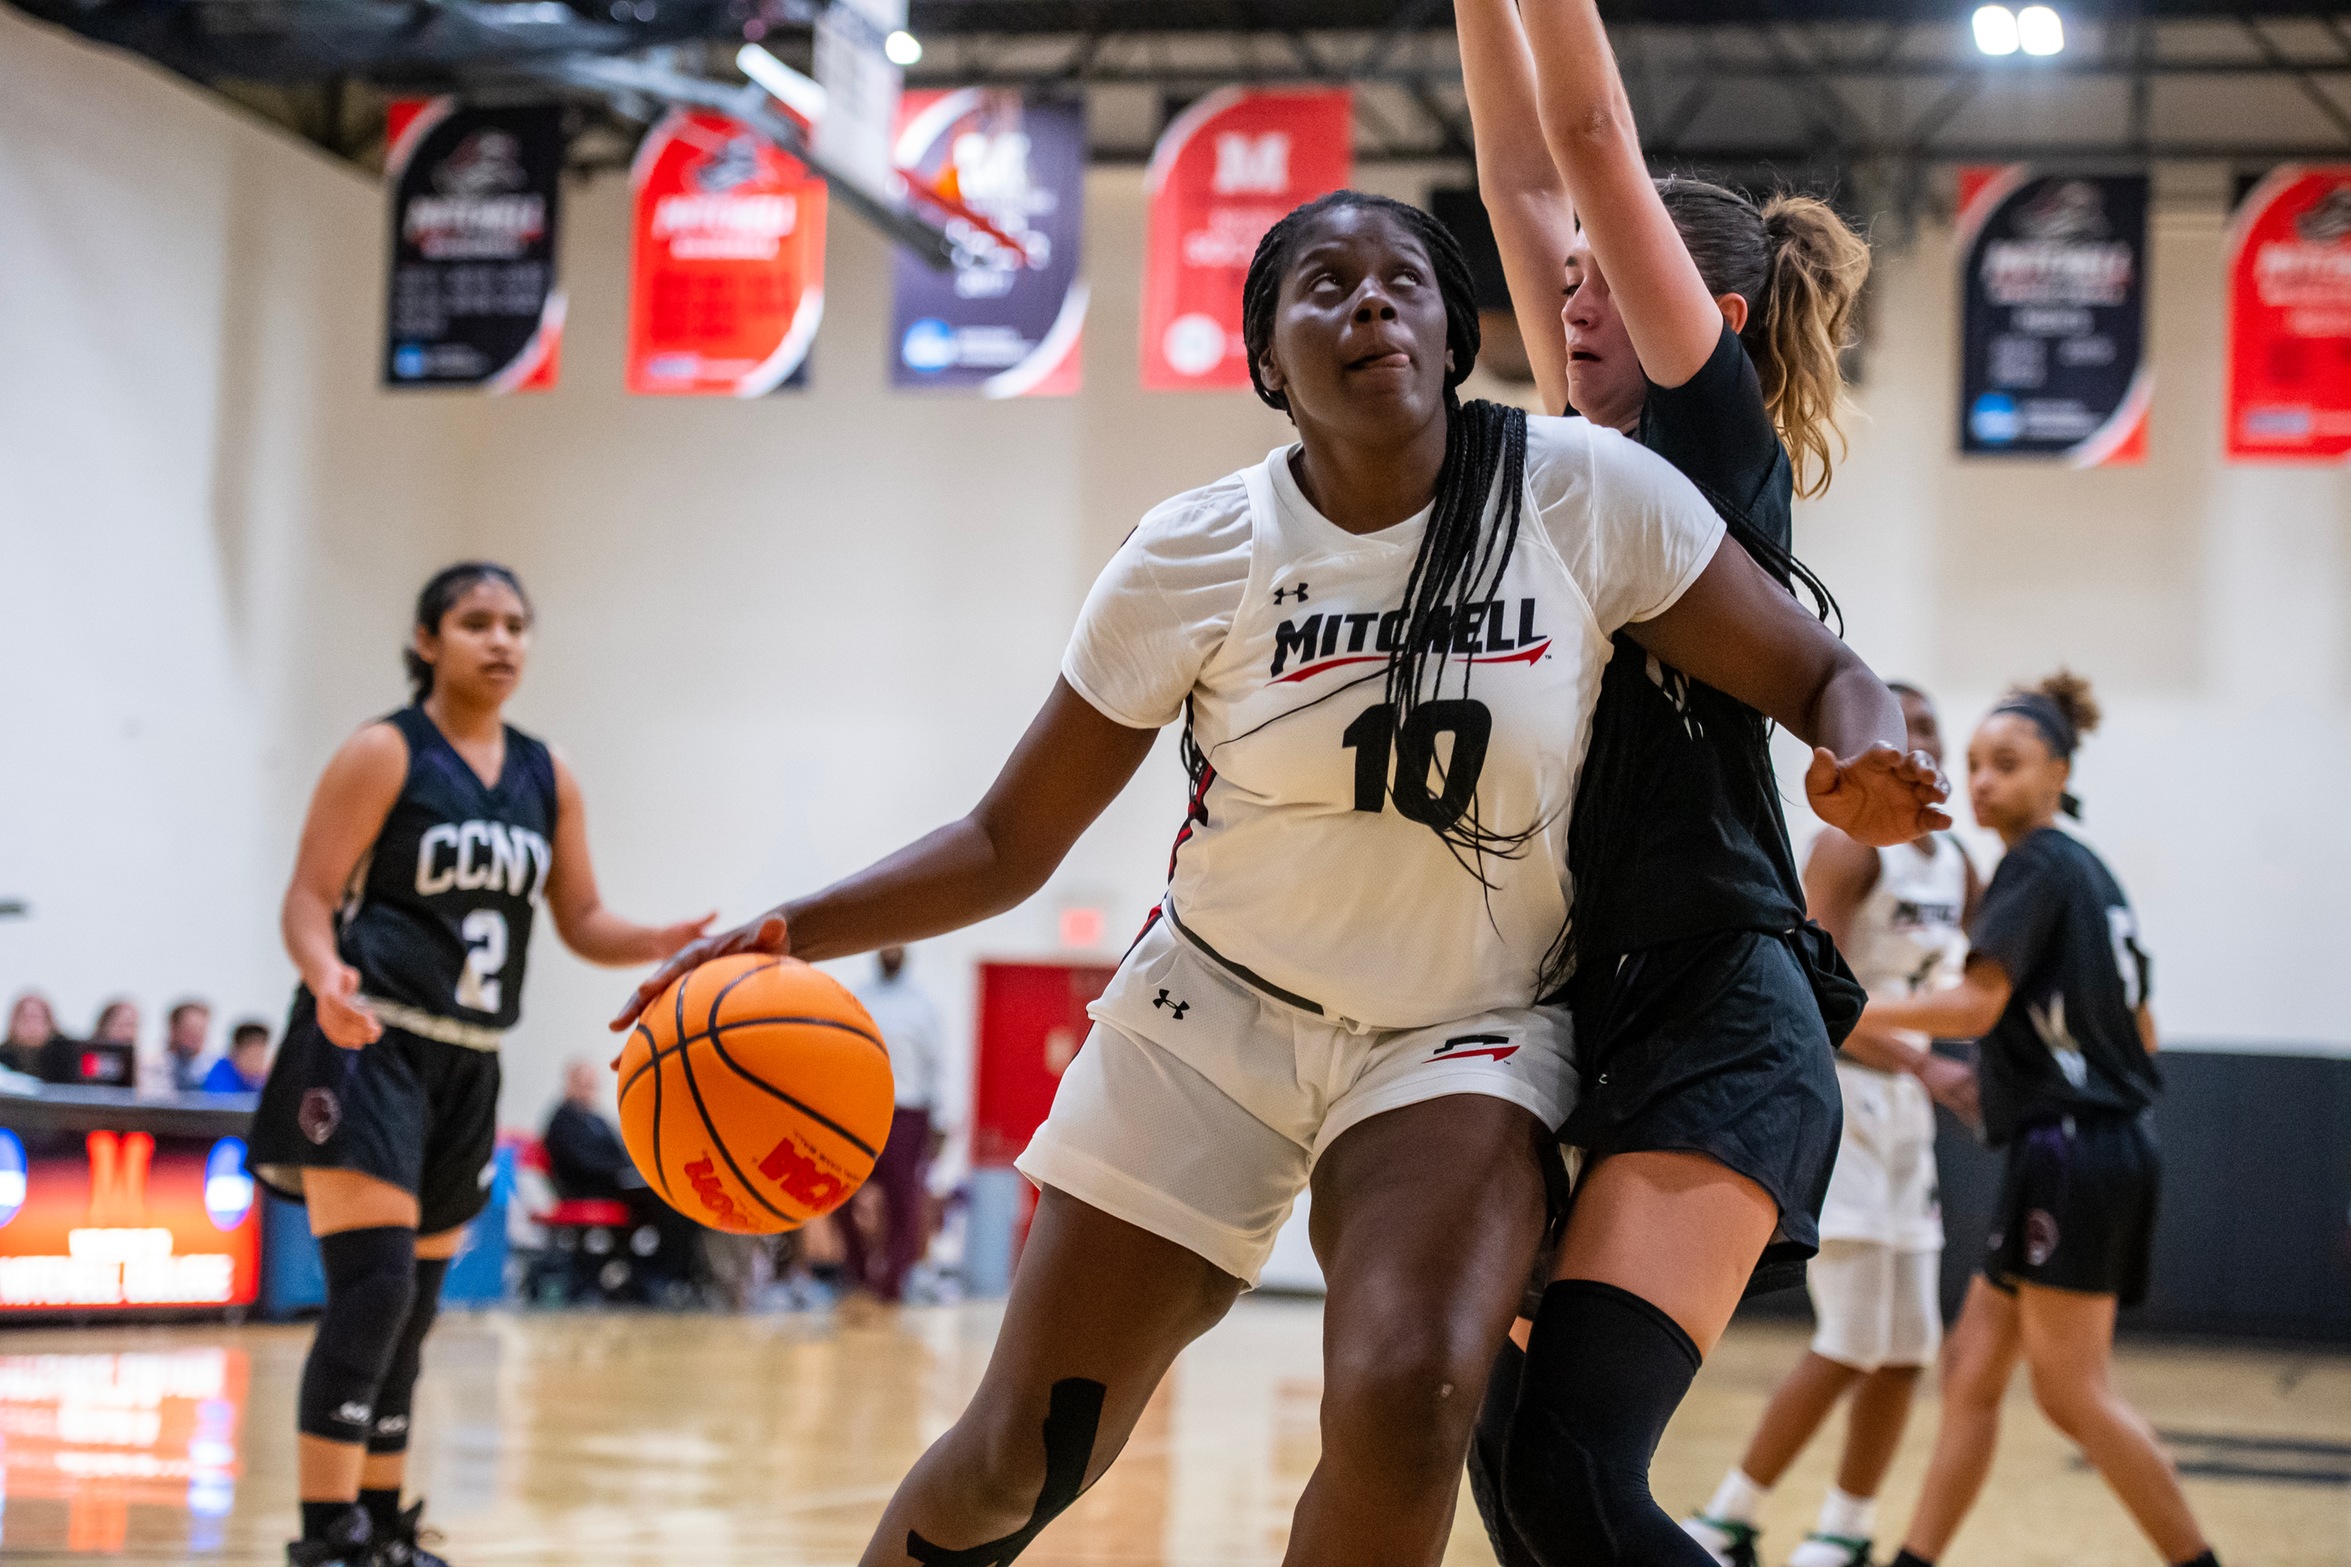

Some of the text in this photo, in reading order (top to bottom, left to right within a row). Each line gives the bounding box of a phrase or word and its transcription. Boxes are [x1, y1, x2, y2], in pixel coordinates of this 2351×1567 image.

[1213, 131, 1290, 195] M
[1342, 698, 1493, 832] 10
[414, 818, 553, 906] CCNY
[453, 907, 509, 1015] 2
